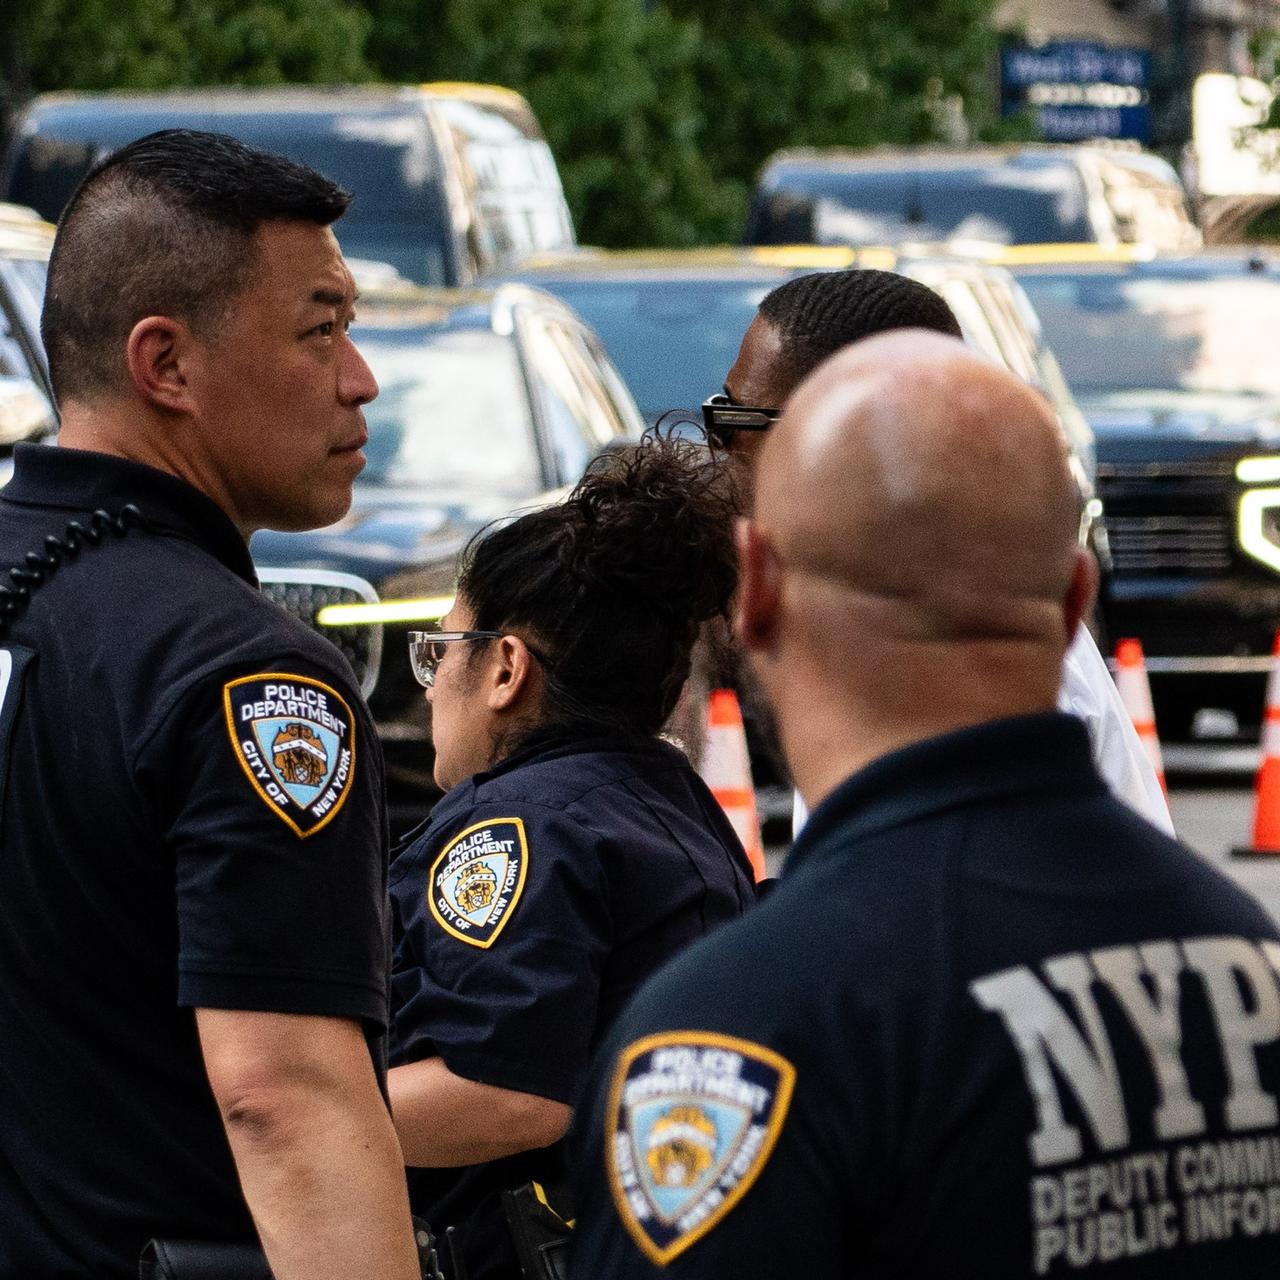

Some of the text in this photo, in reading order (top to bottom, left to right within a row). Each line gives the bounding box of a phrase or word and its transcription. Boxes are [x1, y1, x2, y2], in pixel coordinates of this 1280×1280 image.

[241, 700, 347, 737] DEPARTMENT
[265, 685, 328, 710] POLICE
[242, 740, 289, 806] CITY OF
[311, 748, 351, 817] NEW YORK
[436, 840, 515, 887] DEPARTMENT
[448, 830, 493, 862] POLICE
[438, 897, 472, 931] CITY OF
[487, 859, 519, 926] NEW YORK
[1031, 1152, 1169, 1224] DEPUTY
[1032, 1200, 1181, 1276] PUBLIC
